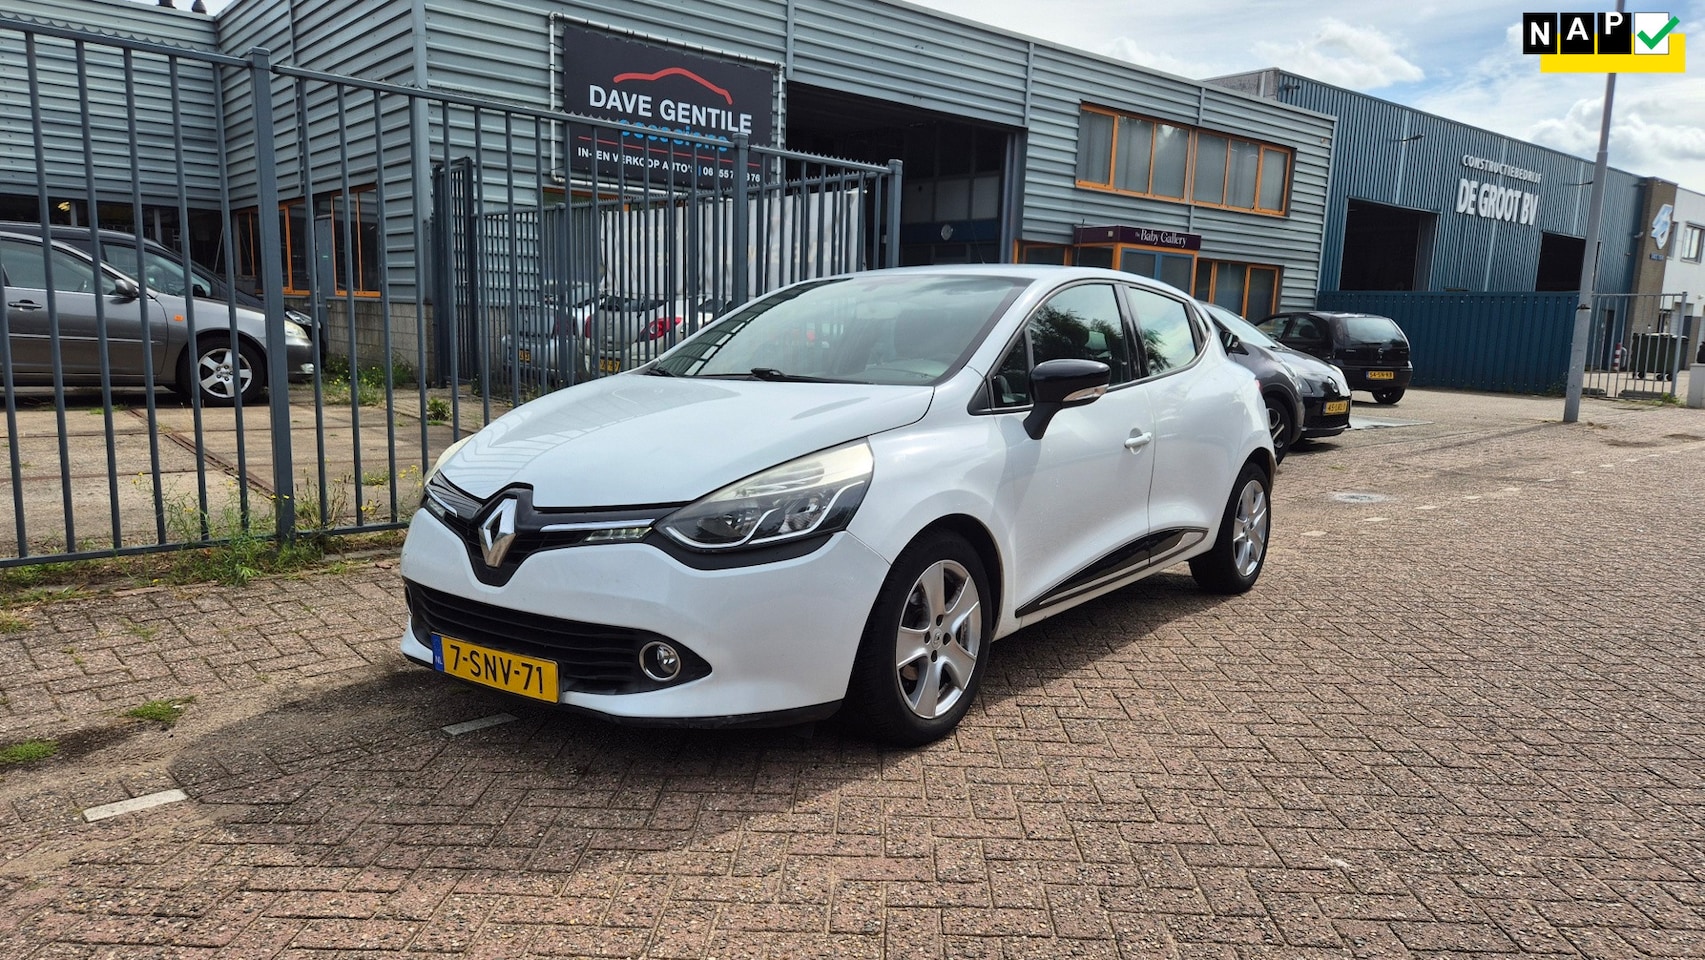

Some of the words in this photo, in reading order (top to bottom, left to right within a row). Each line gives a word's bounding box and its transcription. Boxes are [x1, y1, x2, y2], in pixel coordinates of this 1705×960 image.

[589, 84, 652, 117] DAVE
[659, 99, 752, 134] GENTILE
[578, 147, 592, 158] IN-
[596, 150, 610, 162] EN
[703, 167, 714, 176] 06
[1456, 178, 1479, 215] DE
[1478, 183, 1522, 222] GROOT
[1520, 191, 1539, 226] BV
[1140, 229, 1158, 245] Baby
[1160, 231, 1187, 248] Gallery
[435, 655, 443, 665] NL
[450, 644, 543, 694] 7-SNV-71
